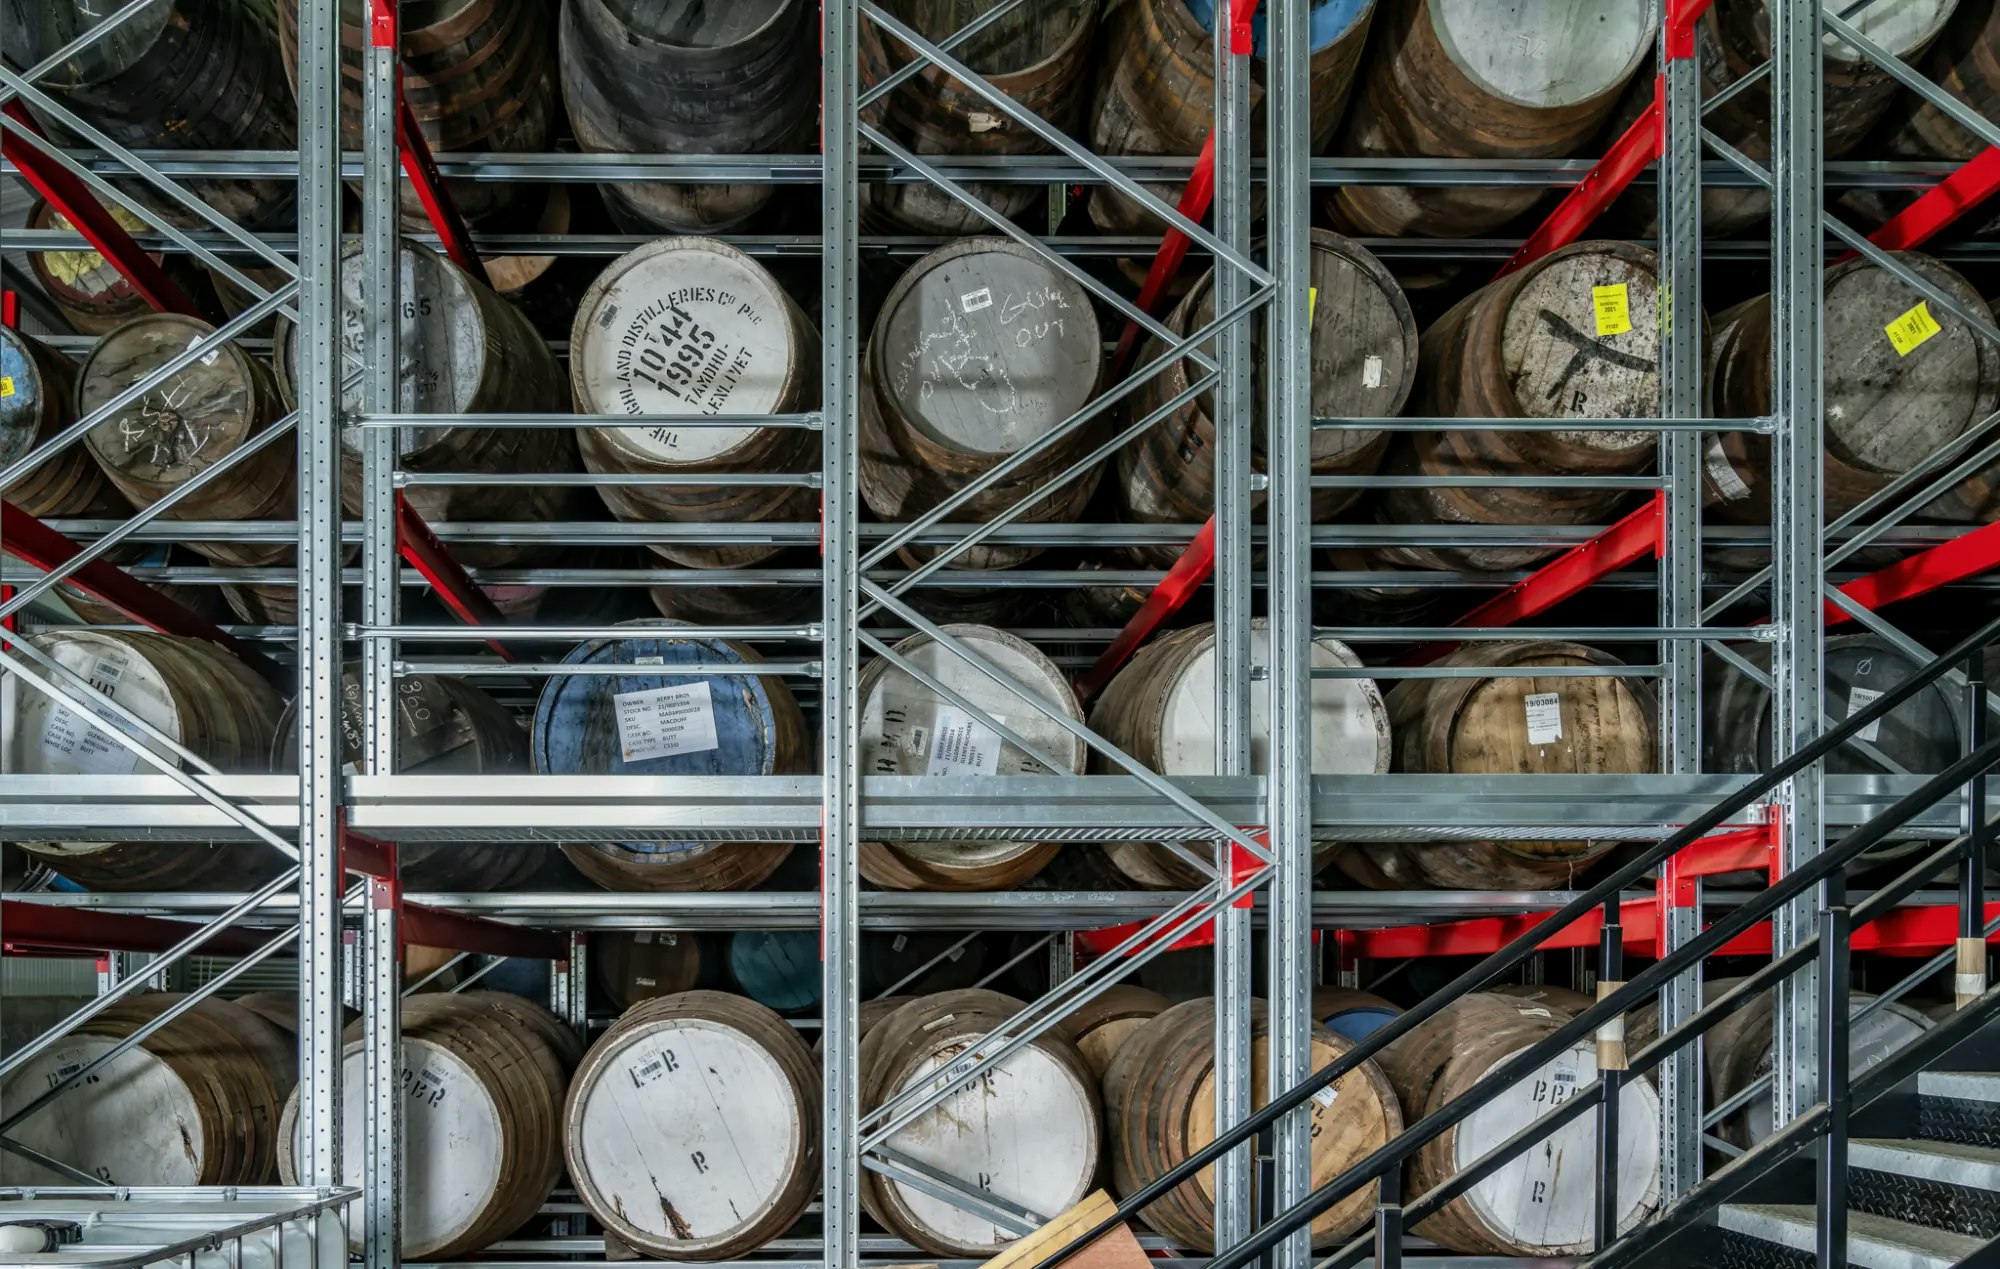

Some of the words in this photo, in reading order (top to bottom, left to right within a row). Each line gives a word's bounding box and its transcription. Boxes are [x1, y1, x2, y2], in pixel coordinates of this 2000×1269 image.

[622, 288, 717, 348] DISTILLERIES
[632, 348, 667, 384] 10
[660, 306, 694, 347] 44
[657, 323, 716, 398] 1995
[616, 349, 645, 415] IGHLAND
[1570, 390, 1588, 414] R
[623, 707, 641, 715] STOCK
[1526, 697, 1558, 707] 19/03084
[691, 1151, 709, 1174] R
[1532, 1180, 1546, 1203] R
